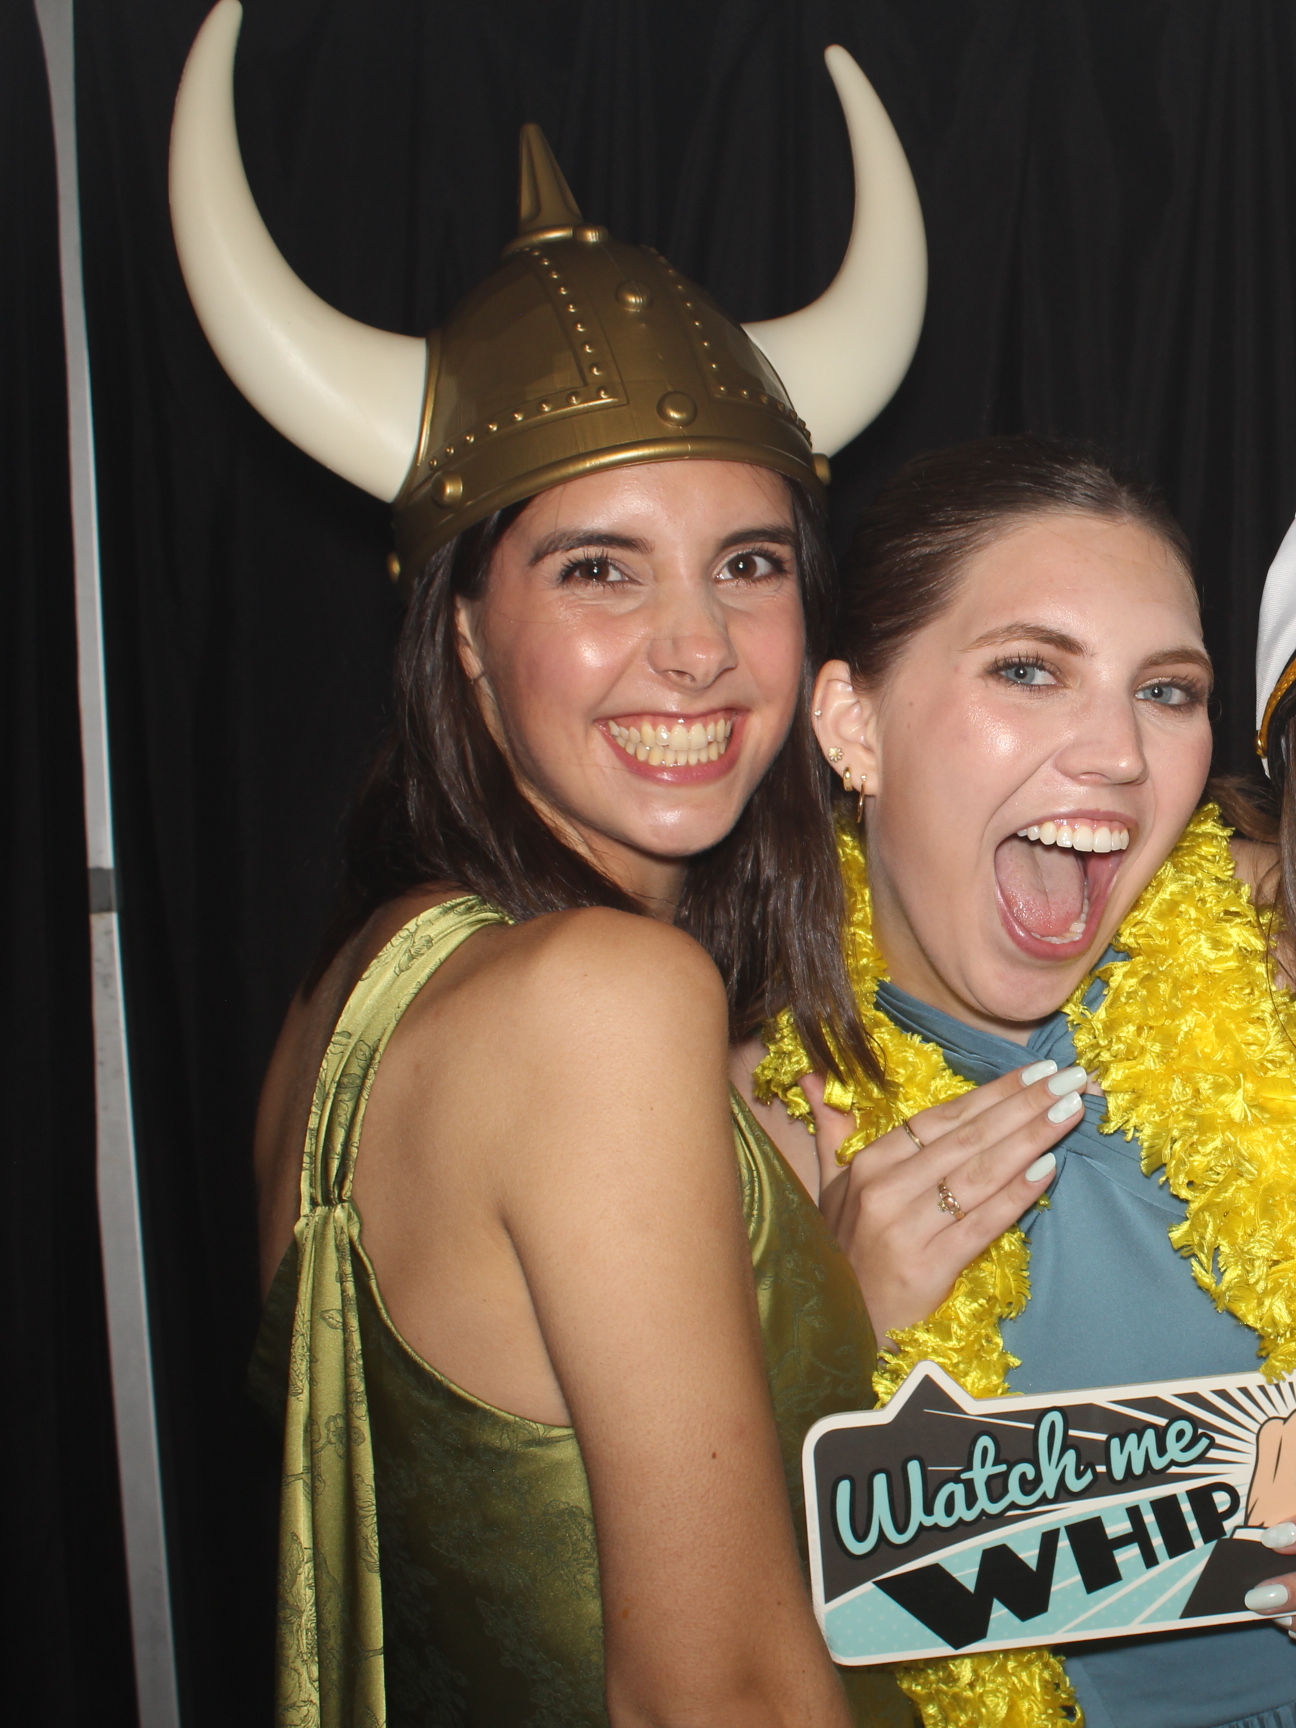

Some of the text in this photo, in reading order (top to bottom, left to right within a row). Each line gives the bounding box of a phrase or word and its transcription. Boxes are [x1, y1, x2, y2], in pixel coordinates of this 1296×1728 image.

[836, 1410, 1212, 1556] Watch me
[872, 1481, 1242, 1651] WHIP
